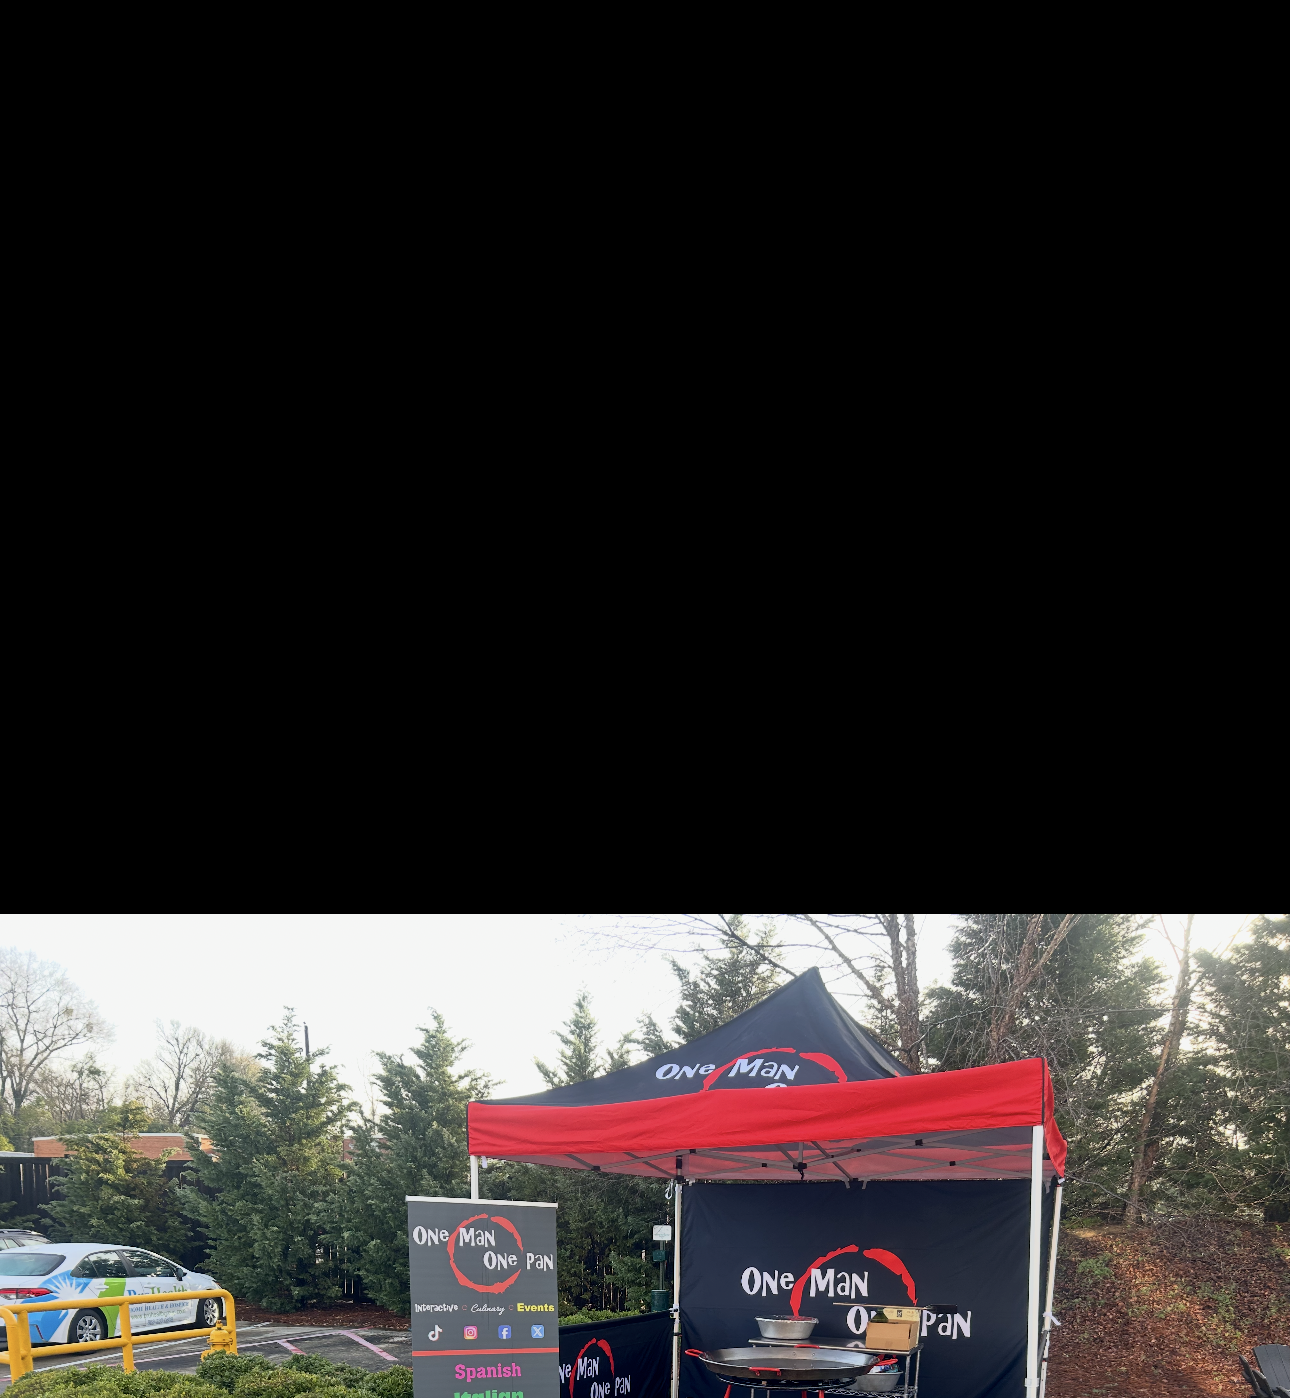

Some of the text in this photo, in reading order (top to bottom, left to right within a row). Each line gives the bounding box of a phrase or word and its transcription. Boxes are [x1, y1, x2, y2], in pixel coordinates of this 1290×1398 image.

[470, 1304, 505, 1315] Culinary
[516, 1303, 555, 1312] Events
[454, 1362, 522, 1382] Spanish
